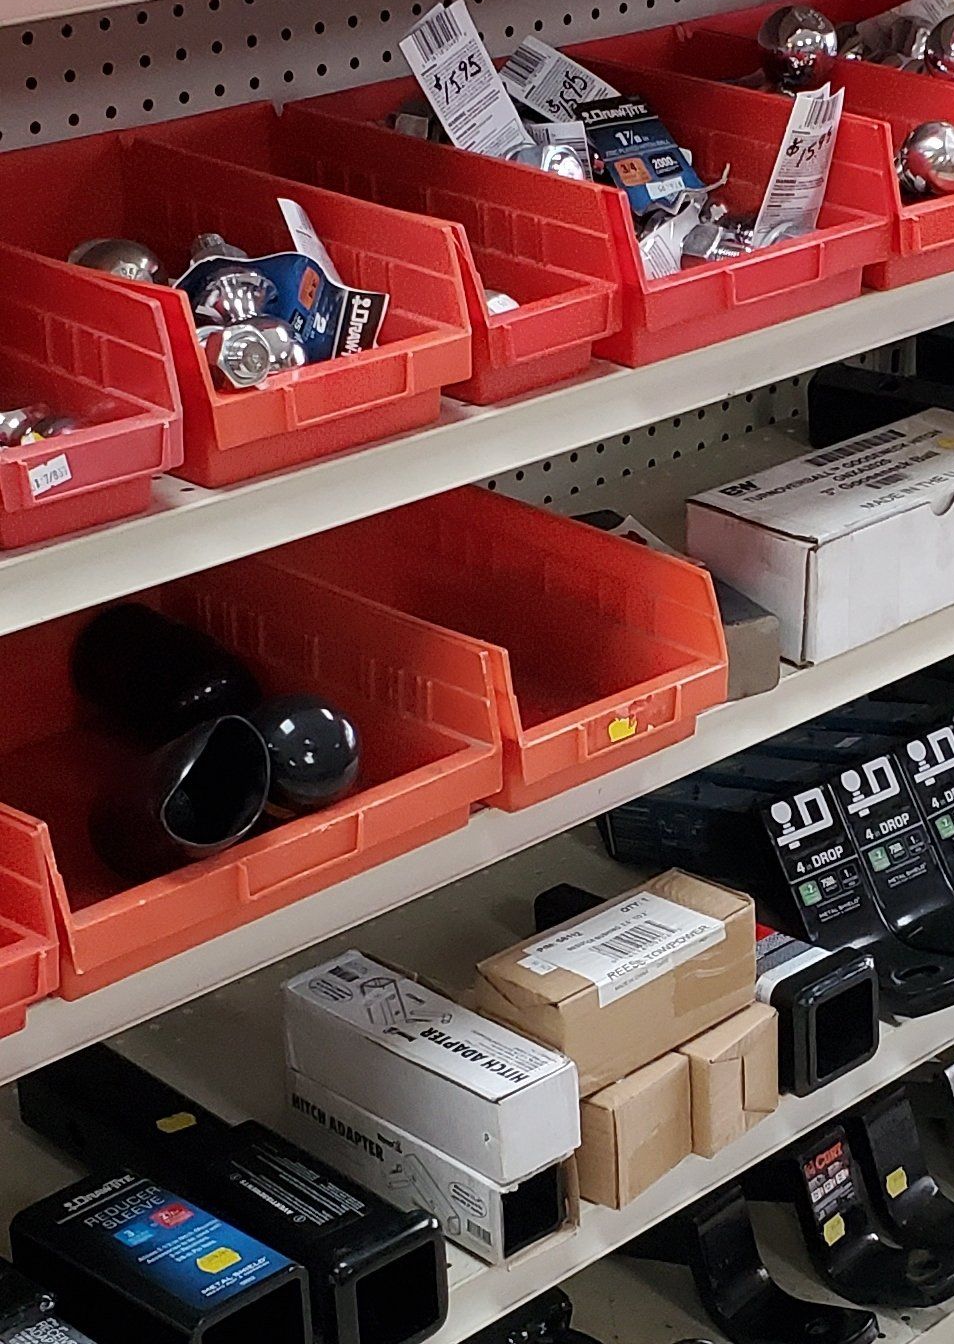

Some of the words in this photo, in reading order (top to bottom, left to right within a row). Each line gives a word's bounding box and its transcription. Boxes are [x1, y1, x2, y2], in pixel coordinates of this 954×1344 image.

[434, 54, 482, 105] $15.95
[652, 157, 672, 169] 2000
[859, 491, 901, 509] MADE
[902, 484, 920, 496] IN
[920, 473, 947, 489] THE
[931, 796, 940, 809] 4
[865, 826, 875, 840] 4
[880, 813, 910, 835] DROP
[796, 859, 806, 874] 4
[812, 846, 844, 868] DROP
[647, 924, 709, 959] TOWPOWER
[420, 1026, 483, 1067] ADAPTER
[481, 1057, 530, 1084] HITCH
[291, 1092, 326, 1126] HITCH
[328, 1115, 385, 1162] ADAPTER
[83, 1185, 163, 1228] REDUCER
[101, 1195, 166, 1230] SLEEVE
